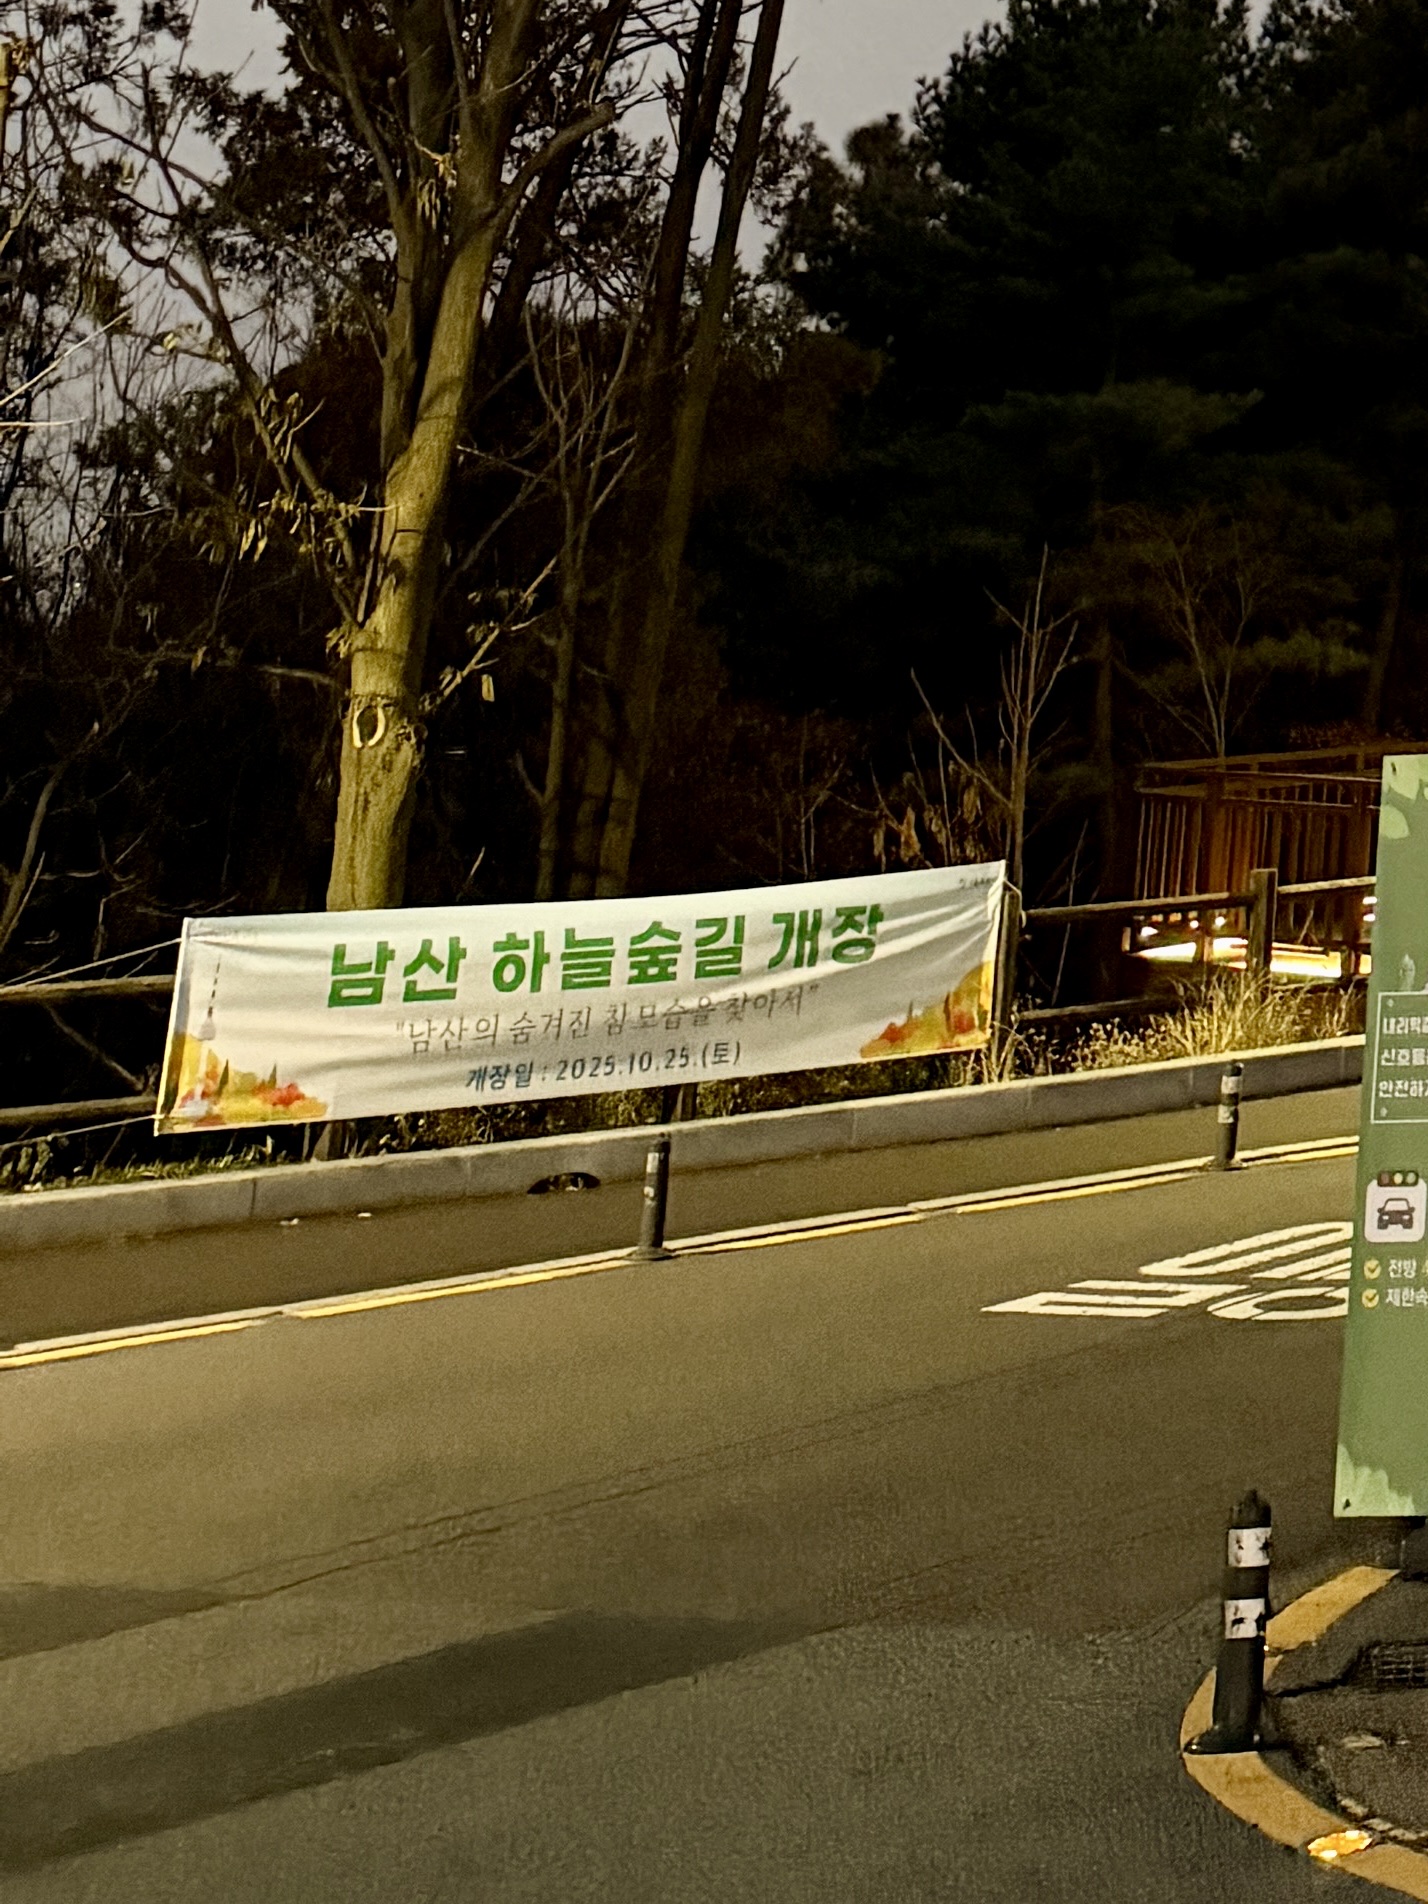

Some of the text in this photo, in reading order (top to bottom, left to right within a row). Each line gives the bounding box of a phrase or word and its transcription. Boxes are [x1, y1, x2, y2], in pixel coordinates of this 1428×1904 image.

[328, 903, 884, 1008] 남산 하늘숲길 개장
[509, 1005, 591, 1044] 숨겨진
[466, 1060, 534, 1092] 개장일
[1387, 1258, 1417, 1279] 전방
